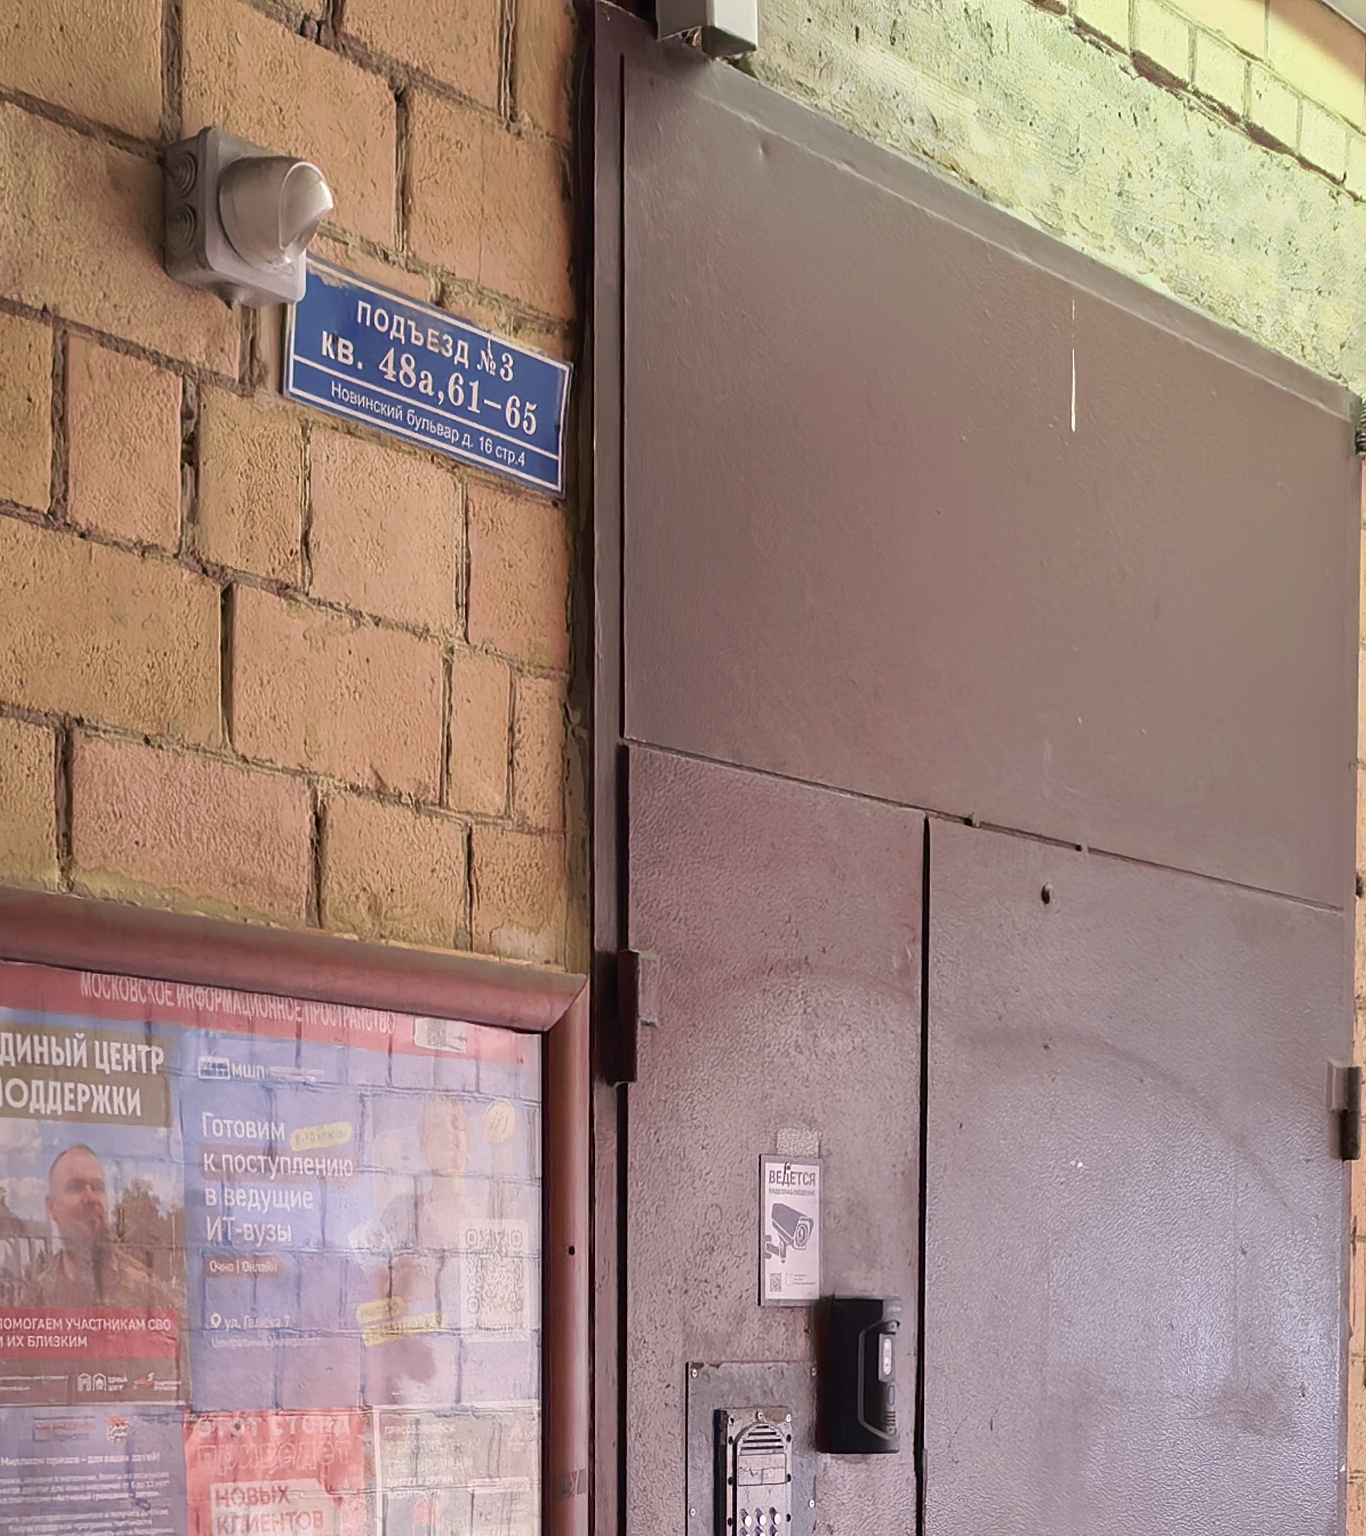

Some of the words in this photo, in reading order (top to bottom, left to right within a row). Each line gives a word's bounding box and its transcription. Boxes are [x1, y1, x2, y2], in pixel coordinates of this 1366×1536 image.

[357, 300, 469, 369] ПОДЪЕЗД
[331, 381, 404, 421] Новинский
[406, 409, 460, 445] бульвар
[462, 435, 474, 450] д.
[479, 436, 493, 454] 16
[80, 972, 175, 1007] МОСКОВСКОЕ
[176, 982, 303, 1023] ИНФОРМАЦИОННОЕ
[305, 1002, 396, 1035] ПРОСТРАНСТВО
[94, 1040, 165, 1076] ЦЕНТР
[201, 1112, 285, 1141] Готовим
[222, 1153, 354, 1180] поступлению
[769, 1170, 816, 1187] ВЕДЕТСЯ
[224, 1188, 314, 1213] ведущие
[206, 1215, 292, 1248] ИТ-вузы
[65, 1317, 146, 1332] УЧАСТНИКАМ
[148, 1318, 172, 1332] СВО
[7, 1336, 24, 1348] ИХ
[27, 1335, 88, 1348] БЛИЗКИМ
[214, 1485, 290, 1508] НОВЫХ
[217, 1510, 323, 1535] КЛИЕНТОВ
